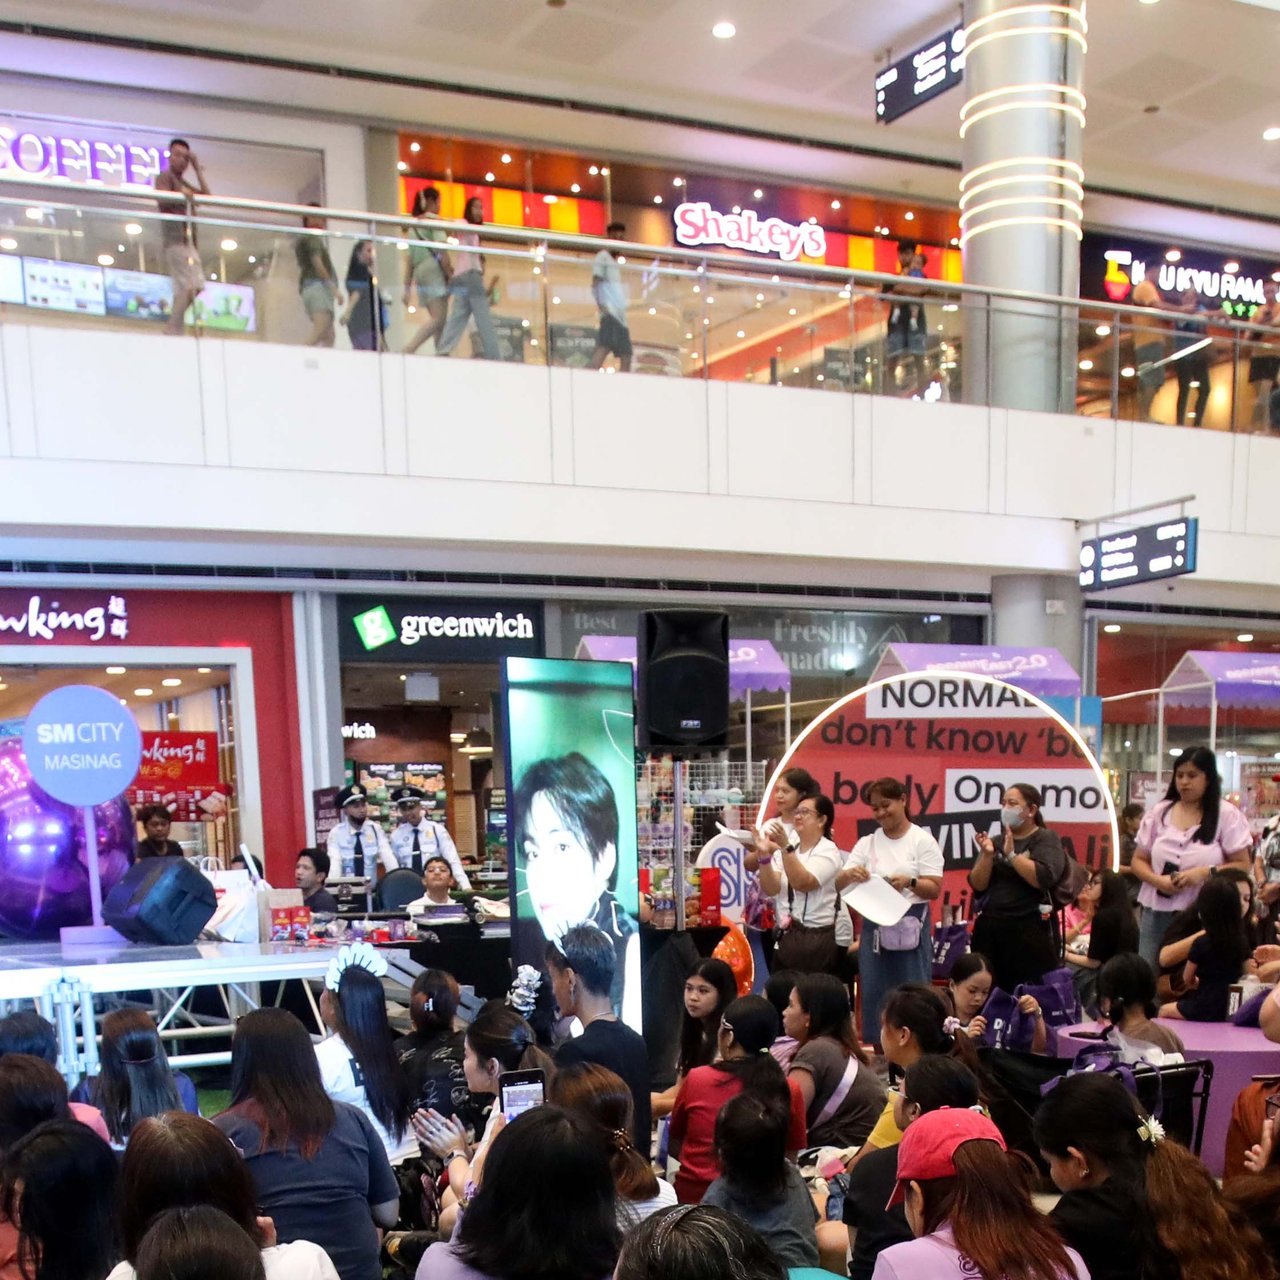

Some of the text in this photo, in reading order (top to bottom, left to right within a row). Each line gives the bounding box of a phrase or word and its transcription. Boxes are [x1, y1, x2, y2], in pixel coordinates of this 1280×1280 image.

[676, 204, 824, 259] Shakey's
[400, 611, 535, 646] greenwich
[574, 613, 617, 630] Best
[774, 619, 868, 649] Freshly
[37, 722, 124, 744] SM CITY
[821, 714, 917, 748] don't
[926, 718, 1028, 754] know
[44, 752, 121, 771] MASINAG
